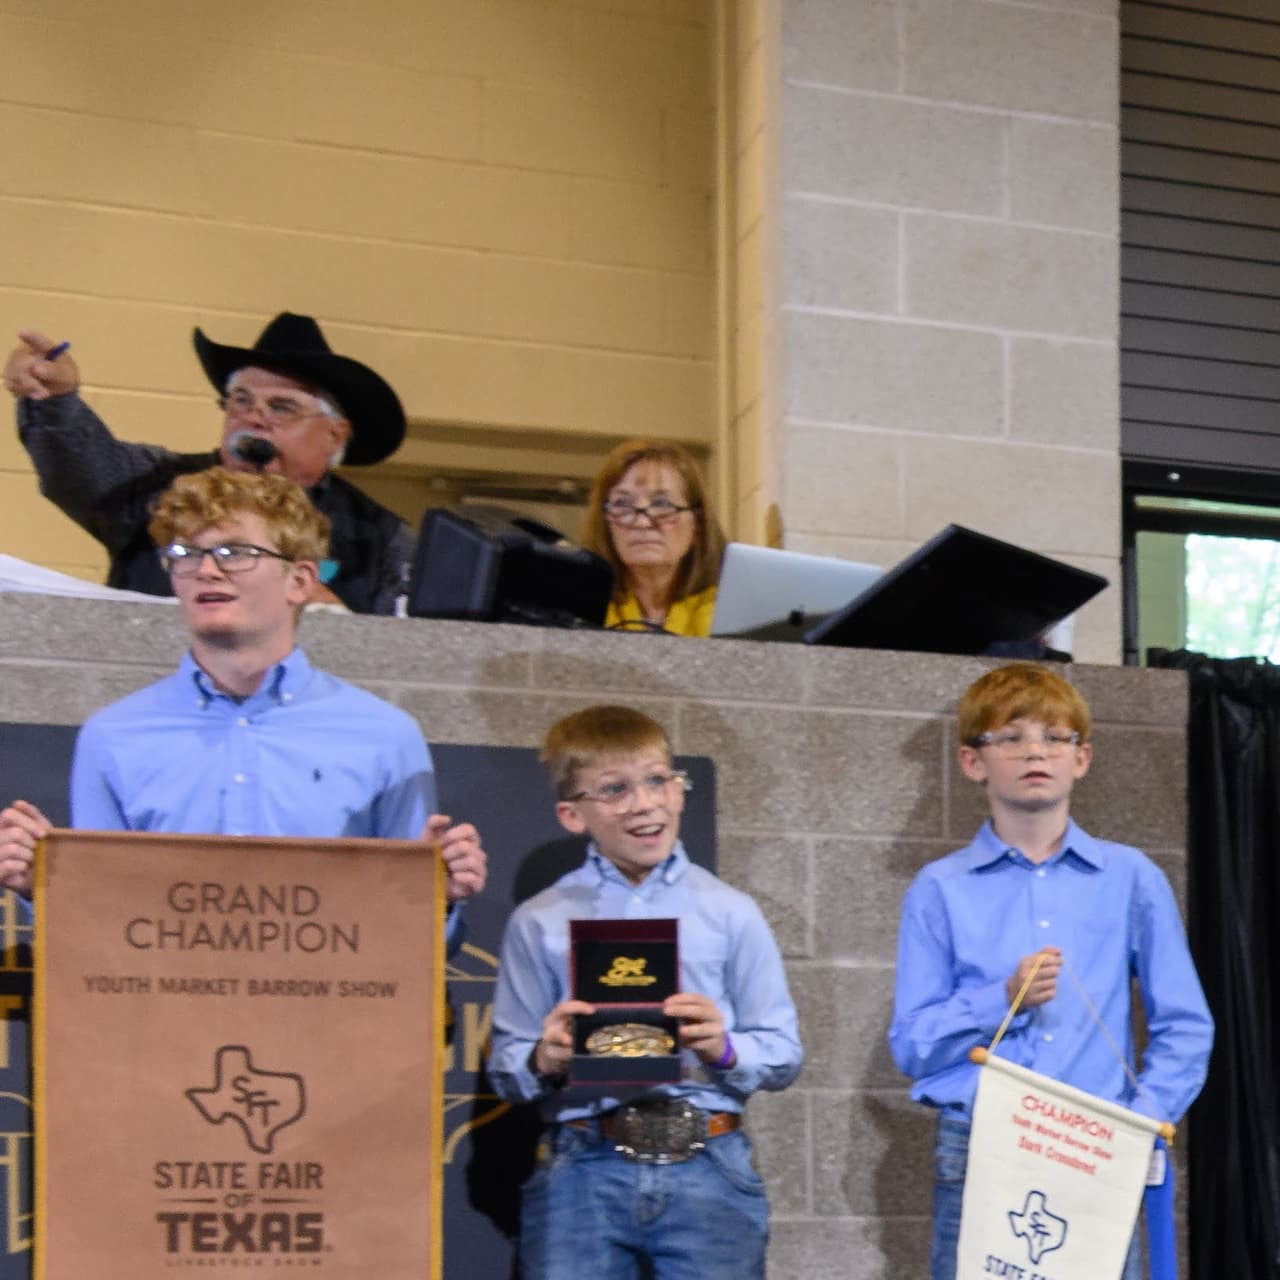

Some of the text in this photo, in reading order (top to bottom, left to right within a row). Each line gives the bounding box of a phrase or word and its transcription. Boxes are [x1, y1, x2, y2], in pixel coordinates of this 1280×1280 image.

[168, 881, 320, 917] GRAND
[124, 917, 360, 953] CHAMPION
[83, 976, 397, 998] YOUTH MARKET BARROW SHOW
[1022, 1095, 1113, 1141] CHAMPION
[153, 1162, 324, 1190] STATE FAIR
[224, 1193, 255, 1209] OF
[156, 1212, 324, 1253] TEXAS
